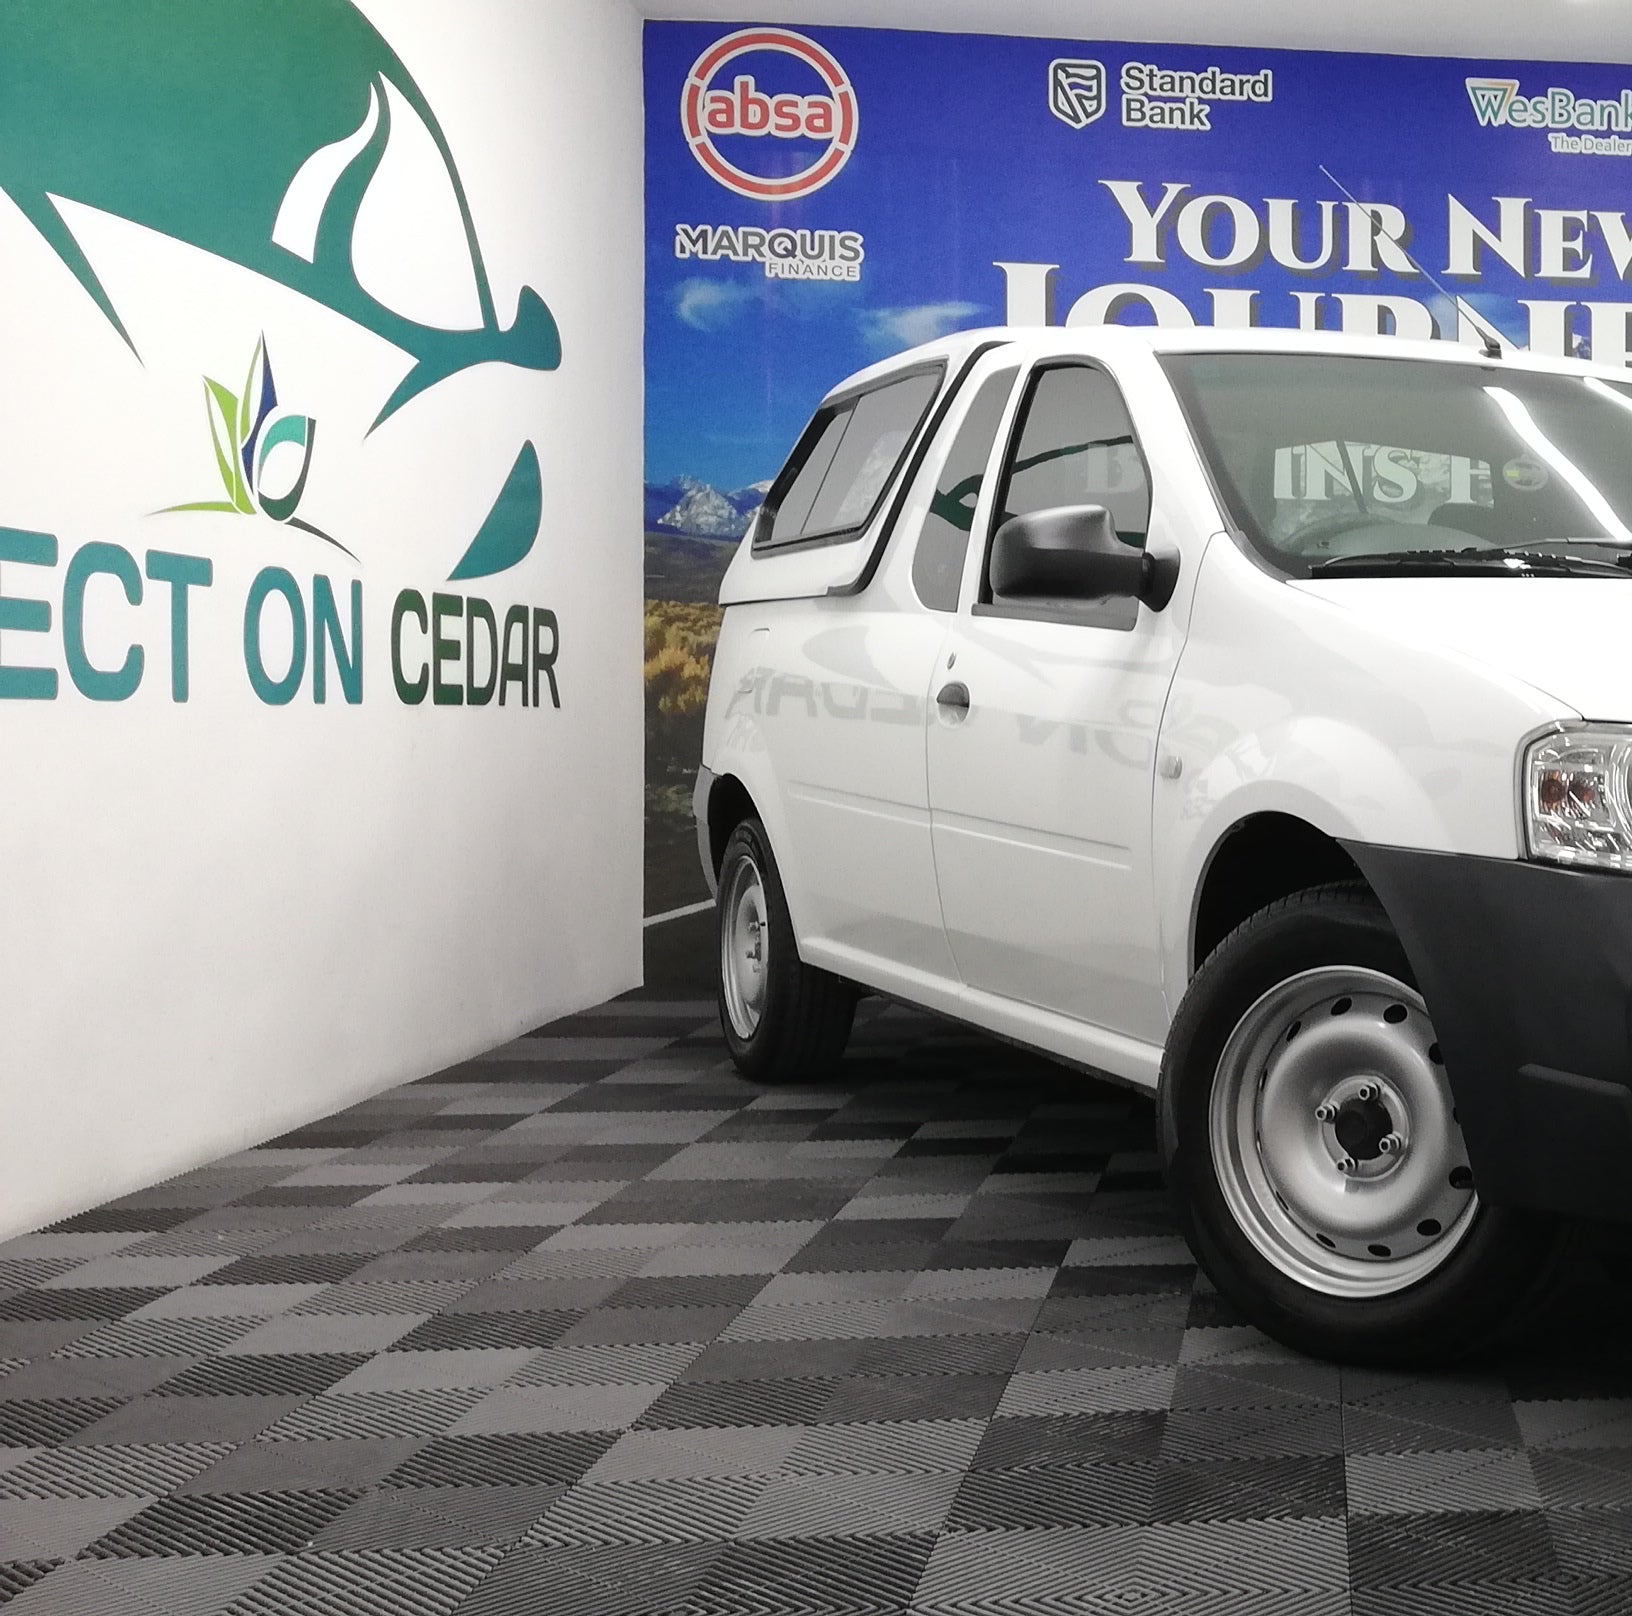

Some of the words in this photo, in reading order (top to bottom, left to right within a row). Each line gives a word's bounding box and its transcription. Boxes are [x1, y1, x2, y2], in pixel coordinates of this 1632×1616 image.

[1123, 65, 1270, 98] Standard
[707, 80, 833, 134] absa
[1125, 98, 1208, 127] Bank
[1551, 136, 1579, 151] The
[1583, 138, 1632, 154] Dealer
[679, 227, 861, 262] MARQUIS
[1098, 180, 1420, 276] YOUR
[768, 262, 858, 278] FINANCE
[243, 565, 363, 705] ON
[391, 588, 561, 708] CEDAR
